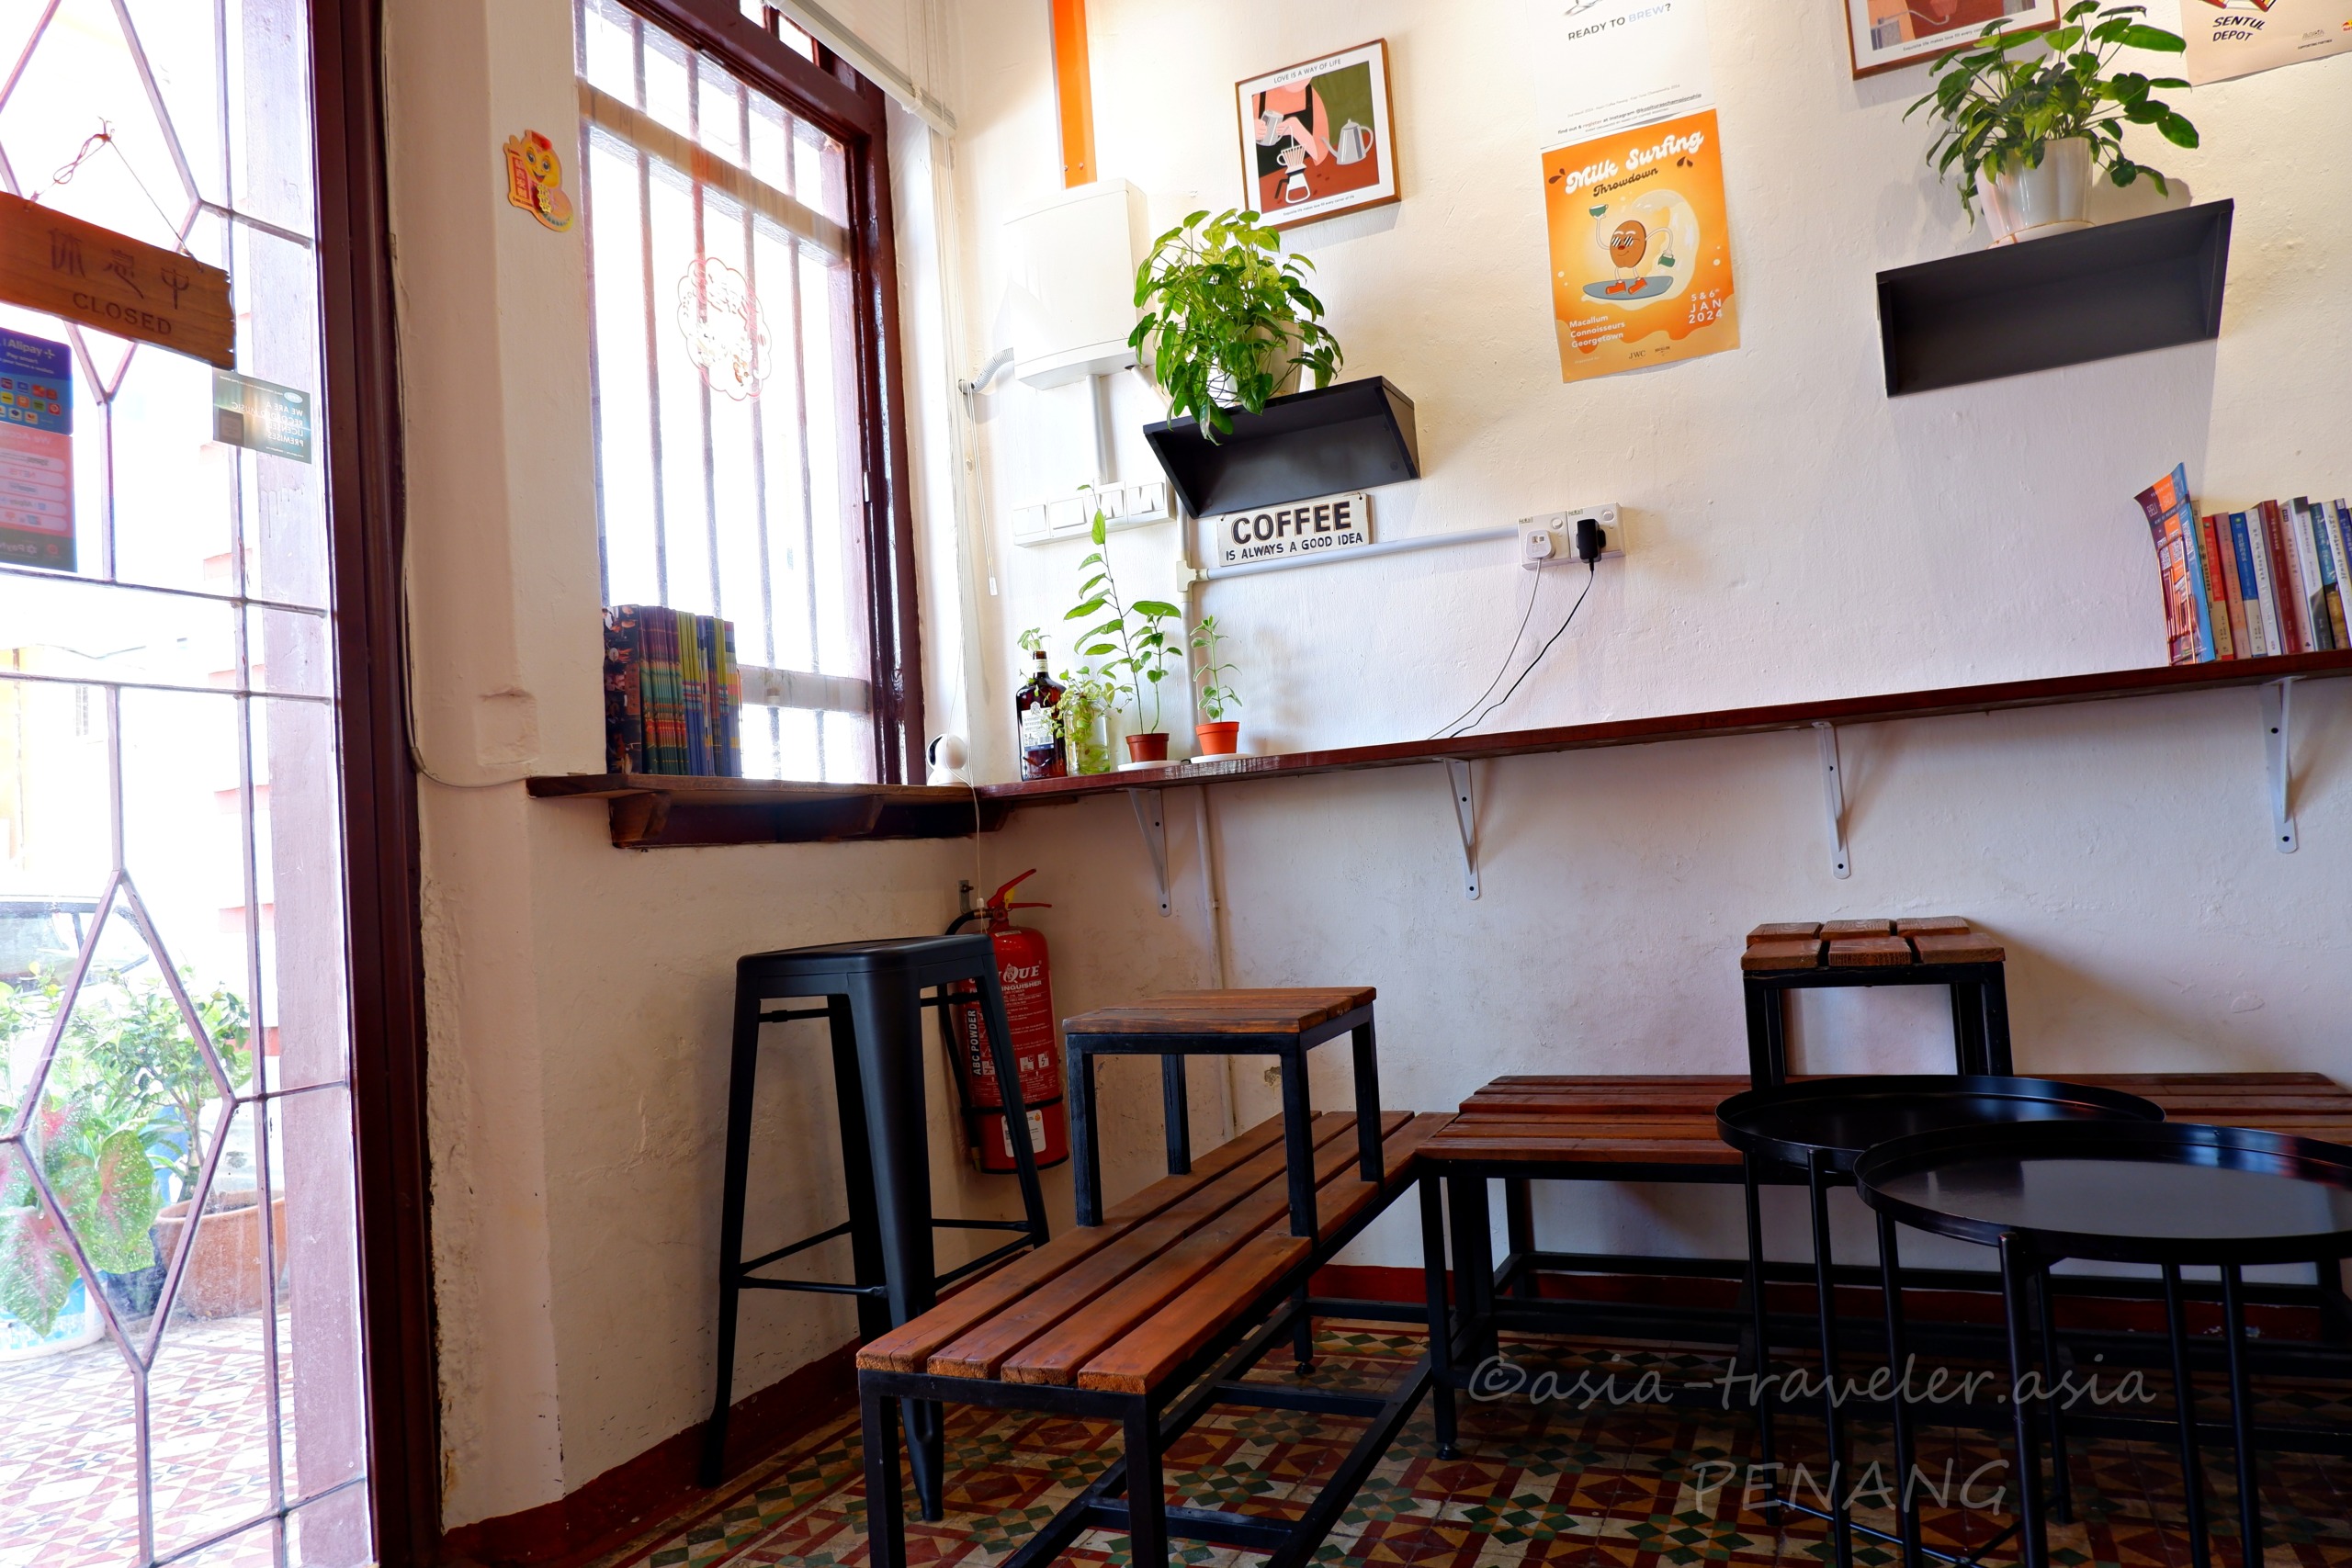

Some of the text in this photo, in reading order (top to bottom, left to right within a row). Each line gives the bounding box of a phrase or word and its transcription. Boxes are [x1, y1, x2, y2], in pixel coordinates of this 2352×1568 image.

[1567, 3, 1671, 40] READY TO BREW?
[2212, 16, 2266, 31] SENTUL
[2212, 29, 2254, 42] DEPOT
[1273, 73, 1289, 84] LOVE
[1303, 65, 1318, 74] WAY
[1318, 62, 1329, 71] OF
[1329, 59, 1341, 68] LIFE
[1582, 118, 1602, 129] register
[1565, 130, 1704, 195] Milk Surfing
[1592, 167, 1658, 197] Throwdown
[48, 228, 190, 310] 休息中
[1691, 293, 1697, 301] 5
[1700, 291, 1706, 300] &
[73, 292, 172, 335] CLOSED
[1569, 315, 1609, 328] Macallum
[1688, 309, 1723, 324] 2024
[1570, 321, 1625, 338] Connoisseurs
[1571, 332, 1623, 348] Georgetown
[1628, 350, 1646, 360] JWC
[1231, 501, 1351, 546] COFFEE
[1226, 532, 1363, 560] IS ALWAYS A GOOD IDEA
[999, 963, 1040, 984] QUE
[1001, 980, 1042, 991] INGUISHER
[967, 1010, 982, 1076] ABC POWDER
